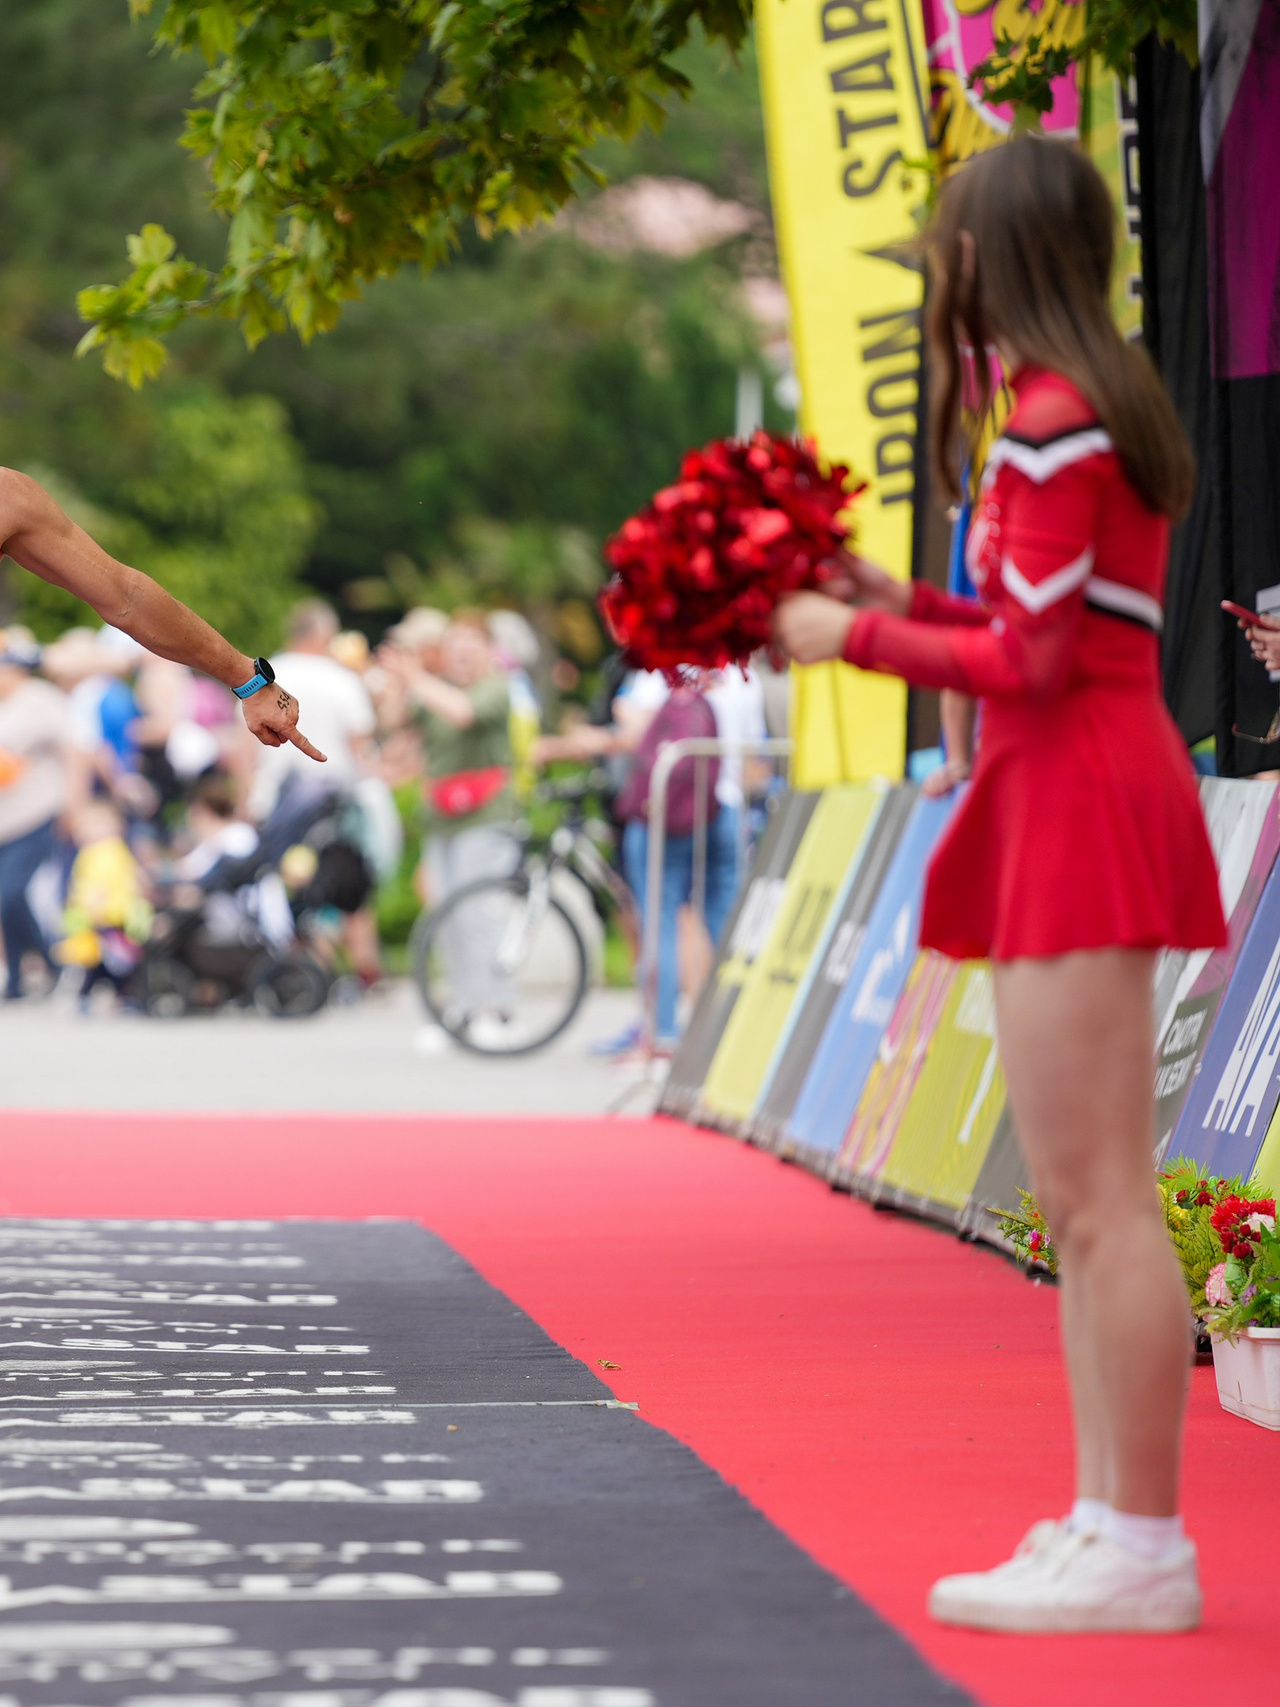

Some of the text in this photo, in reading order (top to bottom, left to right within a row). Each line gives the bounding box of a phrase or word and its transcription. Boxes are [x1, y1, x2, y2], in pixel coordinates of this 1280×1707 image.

[821, 0, 904, 199] STAR
[62, 1338, 370, 1353] STAR
[56, 1386, 397, 1397] STAR
[58, 1410, 416, 1423] STAR
